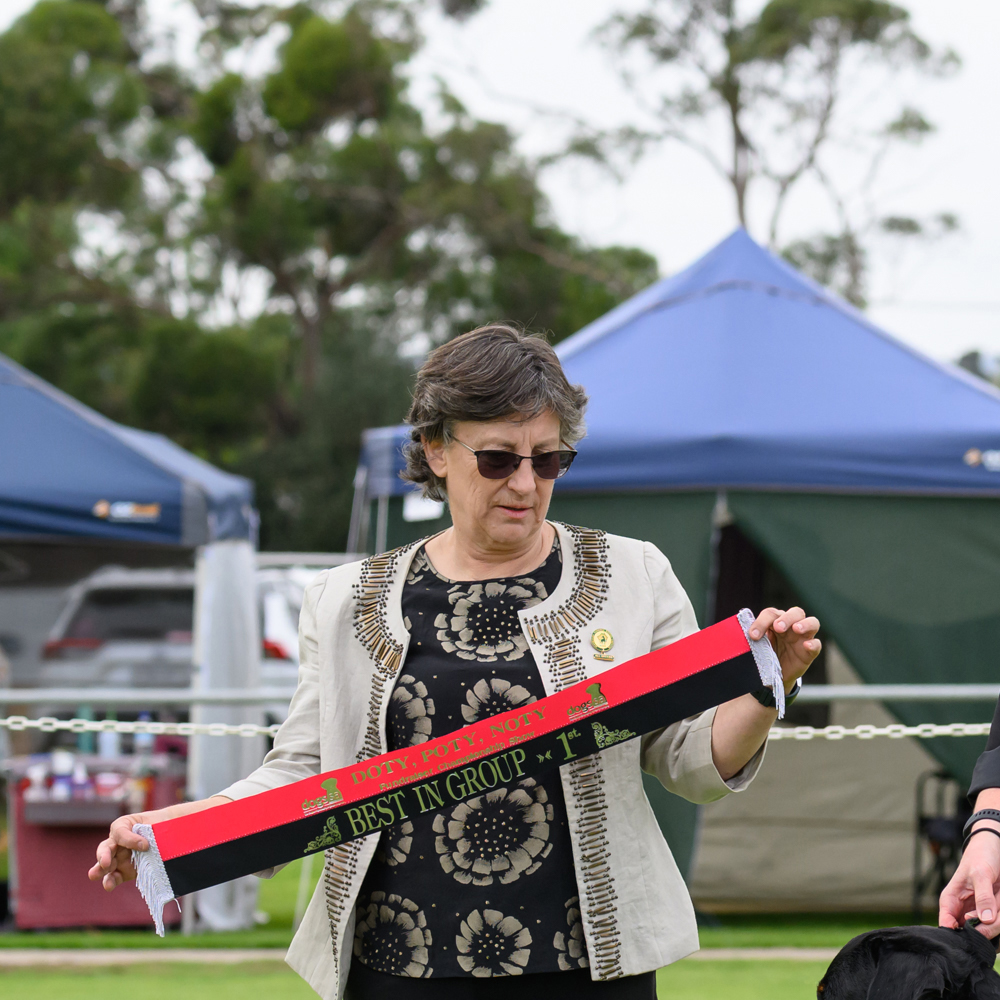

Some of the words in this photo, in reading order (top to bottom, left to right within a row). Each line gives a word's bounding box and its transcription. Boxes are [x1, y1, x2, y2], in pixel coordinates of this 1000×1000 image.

[490, 706, 546, 738] NOTY
[380, 767, 434, 790] Fundraiser
[509, 730, 535, 745] Show
[344, 790, 408, 836] BEST
[412, 779, 445, 813] IN
[446, 748, 526, 800] GROUP
